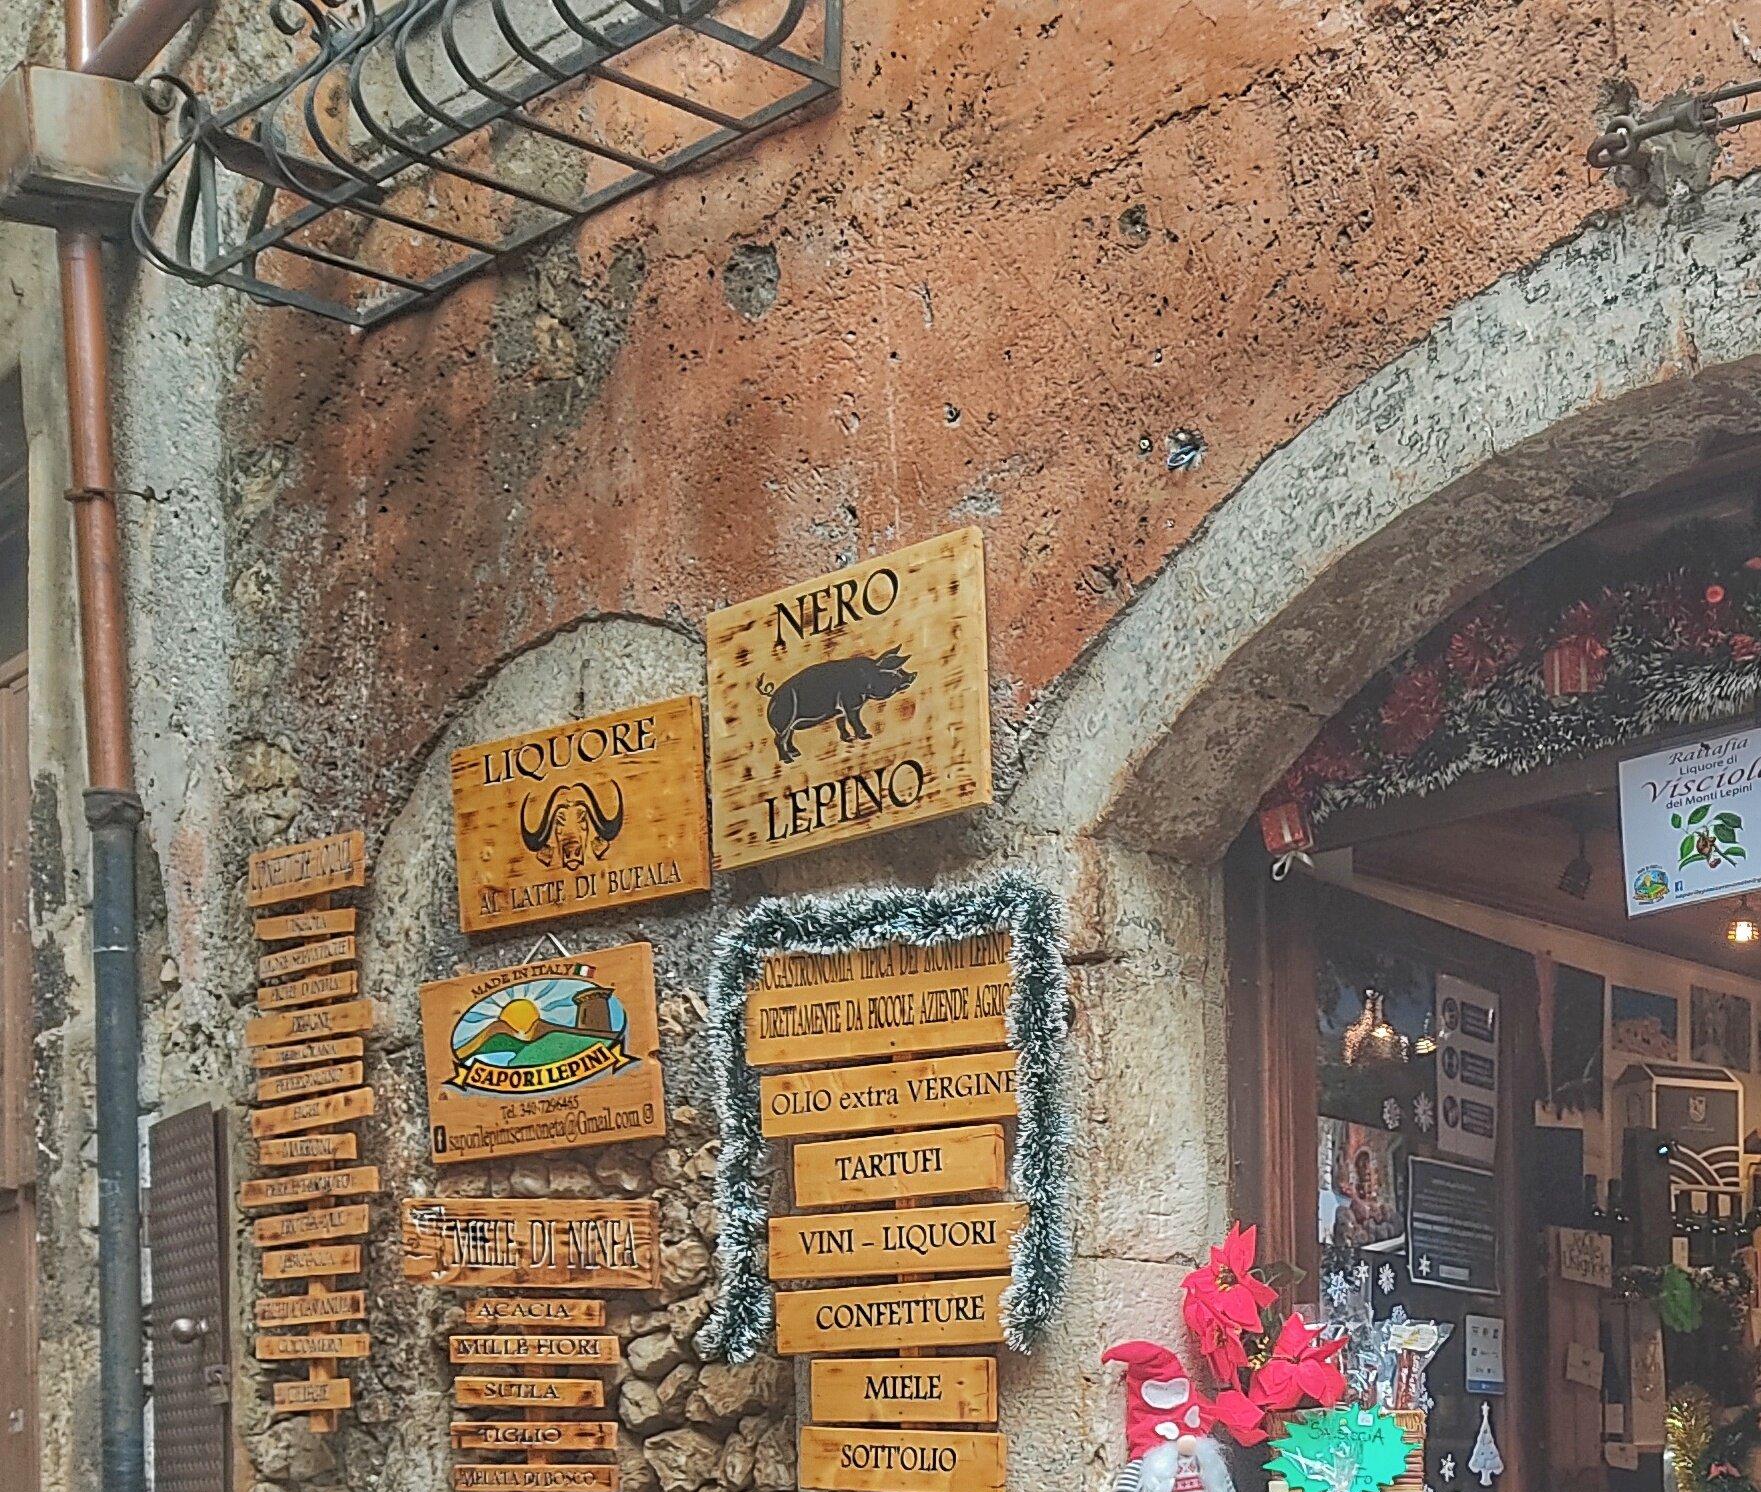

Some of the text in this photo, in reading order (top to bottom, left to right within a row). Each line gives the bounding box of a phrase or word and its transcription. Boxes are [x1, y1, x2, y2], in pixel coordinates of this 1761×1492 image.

[775, 568, 899, 646] NERO
[484, 716, 656, 785] LIQUORE
[1680, 755, 1738, 775] Liquore di
[765, 759, 924, 842] LEPINO
[1685, 793, 1717, 805] Monti
[1720, 783, 1753, 797] Lepini
[480, 859, 681, 915] AL LATTE DI BUFALA
[471, 964, 574, 999] MADE IN ITALY
[760, 1001, 841, 1040] DIRETTAMENTE
[846, 1000, 864, 1031] DA
[868, 993, 915, 1029] PICCOLE
[919, 987, 969, 1024] AZIENDE
[471, 1047, 612, 1088] SAPORI LEPINI
[771, 1070, 1017, 1116] OLIO extra VERGINE
[835, 1148, 943, 1181] TARTUFI
[529, 1219, 557, 1268] DI
[567, 1219, 639, 1269] NINFA
[799, 1229, 854, 1255] VINI
[882, 1220, 997, 1257] LIQUORI
[478, 1303, 570, 1319] ACACIA
[816, 1295, 985, 1330] CONFETTURE
[457, 1339, 601, 1357] MILLE FIORI
[484, 1382, 560, 1399] SULLA
[863, 1375, 942, 1400] MIELE
[480, 1427, 562, 1445] TIGLIO
[841, 1444, 957, 1472] SOTT'OLIO
[524, 1472, 540, 1486] DI
